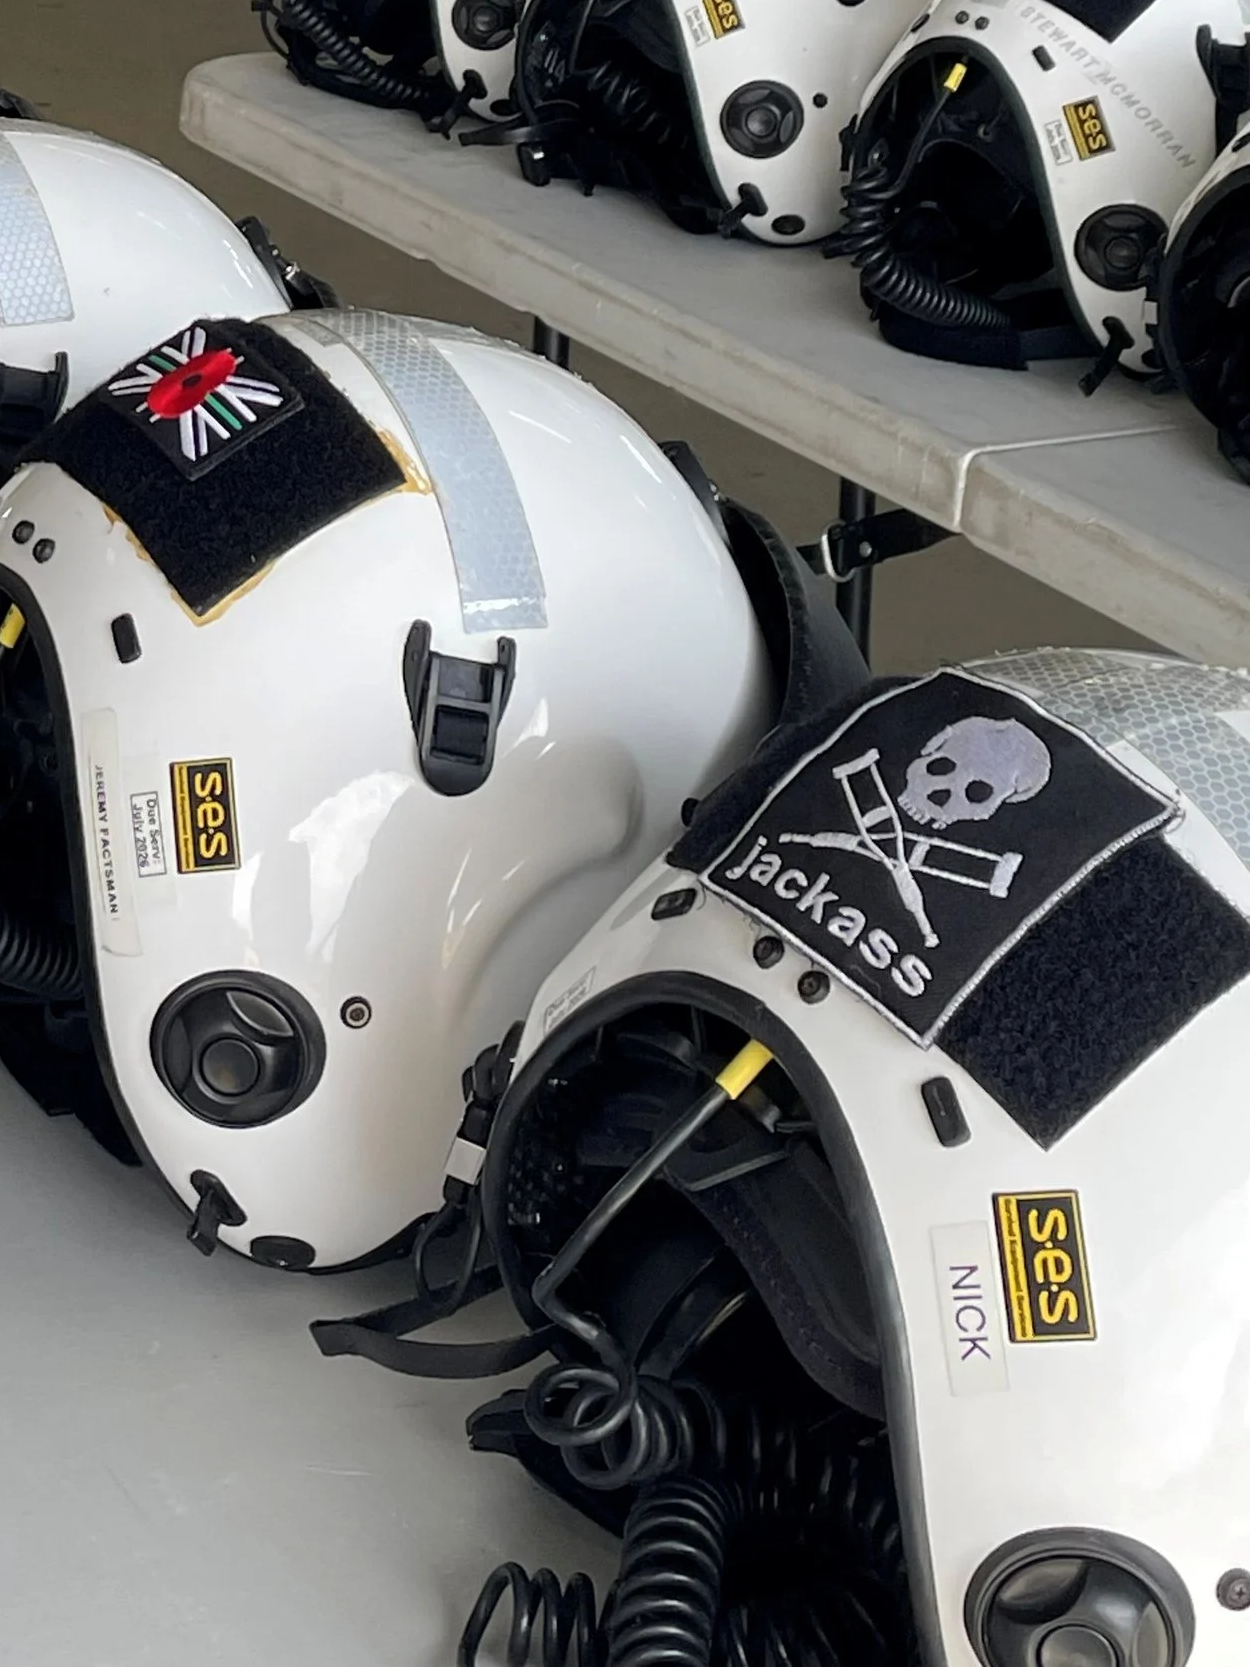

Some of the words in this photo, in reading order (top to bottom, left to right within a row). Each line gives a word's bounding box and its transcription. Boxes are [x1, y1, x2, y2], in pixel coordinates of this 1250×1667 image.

[1019, 5, 1101, 69] STEWART
[95, 764, 109, 823] JEREMY
[132, 803, 145, 834] July
[146, 798, 157, 826] Due
[100, 827, 119, 915] FACTSMAN
[724, 835, 932, 998] jackass
[949, 1265, 991, 1361] NICK
